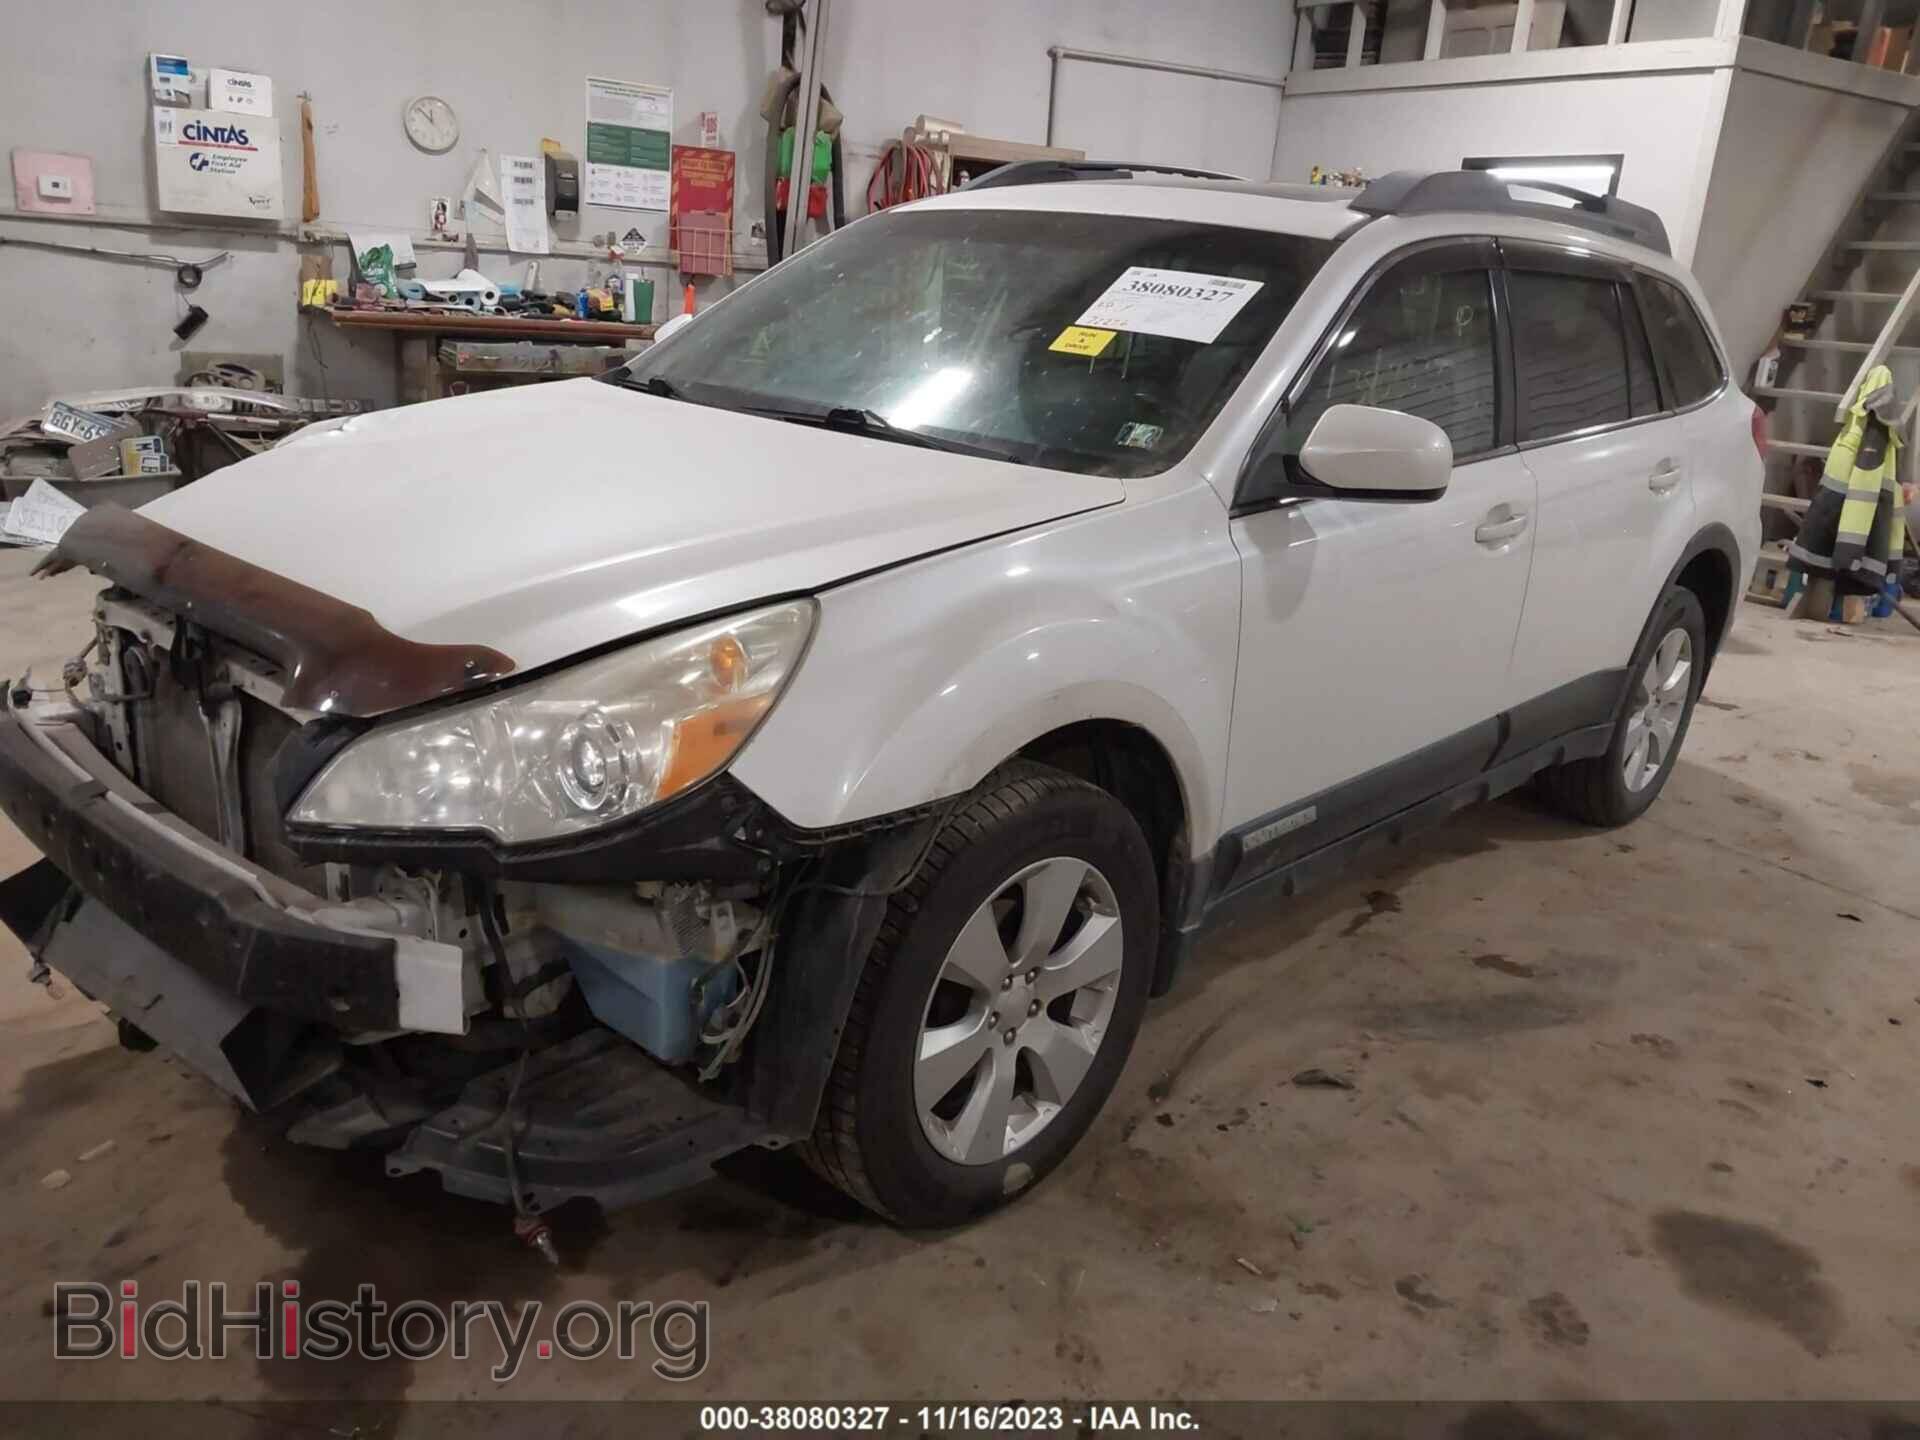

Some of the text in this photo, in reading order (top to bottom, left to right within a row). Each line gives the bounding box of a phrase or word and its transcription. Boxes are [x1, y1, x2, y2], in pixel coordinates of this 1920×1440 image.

[212, 153, 247, 164] Employee
[209, 167, 236, 175] Station
[1122, 280, 1235, 302] 38080327
